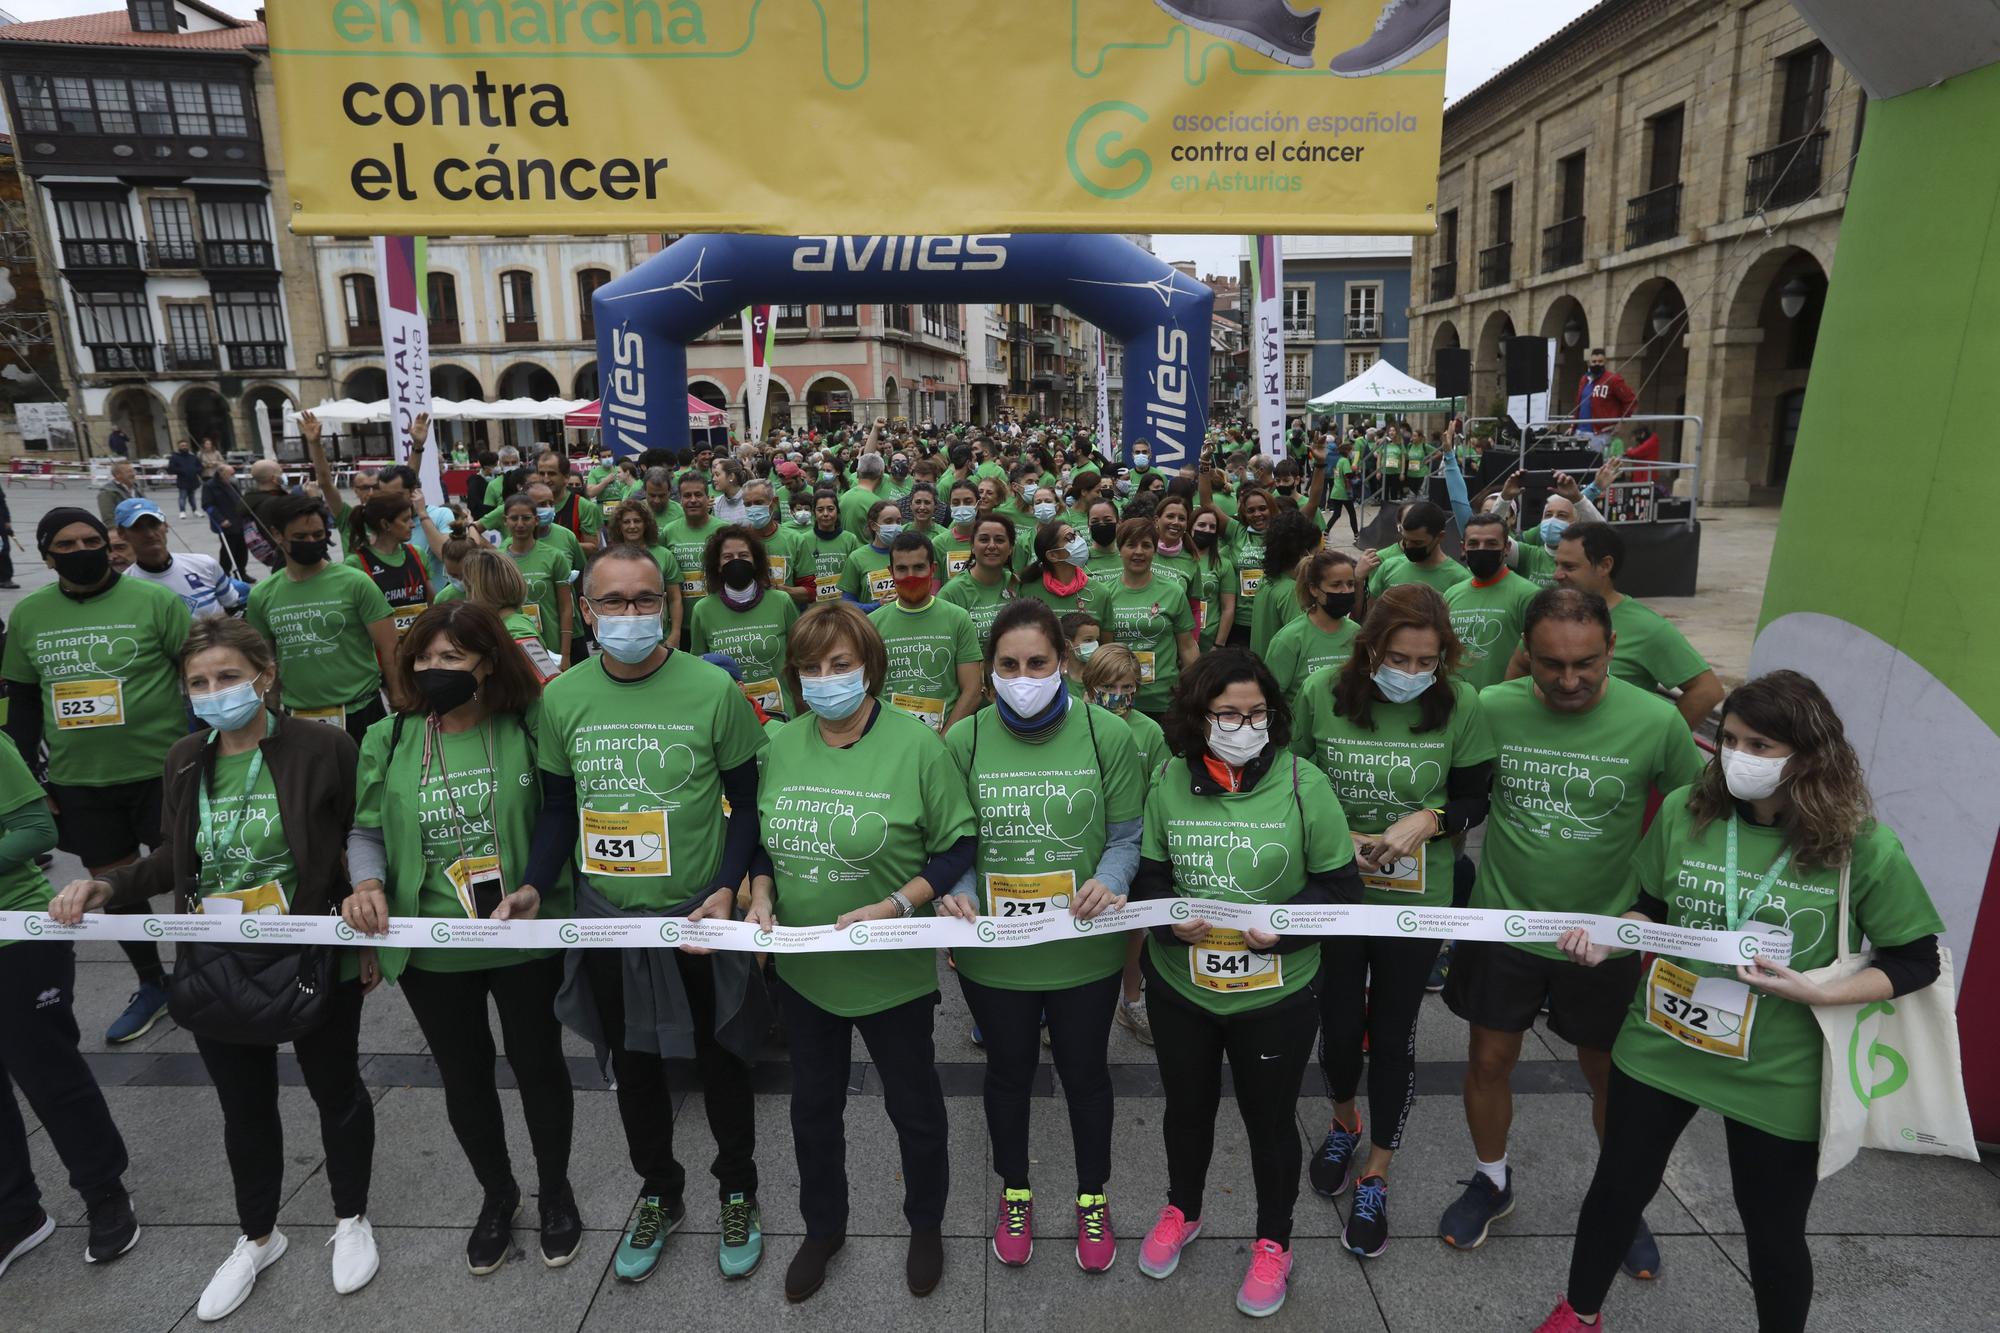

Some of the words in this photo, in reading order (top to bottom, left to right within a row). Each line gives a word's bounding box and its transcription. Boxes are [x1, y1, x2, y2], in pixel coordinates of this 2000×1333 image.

[332, 0, 422, 44] en
[444, 0, 706, 45] marcha
[343, 71, 568, 127] contra
[1173, 111, 1299, 132] asociación
[1307, 111, 1417, 137] española
[1171, 141, 1248, 162] contra
[1255, 141, 1275, 162] el
[1282, 141, 1364, 162] cáncer
[351, 143, 417, 200] el
[434, 144, 668, 200] cáncer
[1171, 174, 1199, 192] en
[1206, 171, 1302, 192] Asturias
[821, 585, 835, 594] 671
[877, 580, 895, 590] 472
[283, 608, 321, 621] marcha
[37, 639, 52, 651] En
[56, 633, 108, 648] marcha
[713, 638, 723, 646] En
[725, 632, 761, 643] marcha
[892, 642, 931, 654] marcha
[53, 662, 96, 676] cáncer
[891, 668, 923, 678] cáncer
[62, 700, 95, 715] 523
[667, 723, 694, 731] CÁNCER
[576, 737, 591, 753] En
[596, 734, 659, 750] marcha
[577, 755, 623, 772] contra
[1327, 747, 1343, 762] En
[1349, 752, 1410, 767] marcha
[1533, 748, 1561, 756] MARCHA
[1562, 752, 1590, 760] CONTRA
[1602, 755, 1629, 765] CÁNCER
[1328, 766, 1374, 783] contra
[1500, 754, 1518, 770] En
[1524, 762, 1589, 779] marcha
[590, 775, 645, 791] cáncer
[979, 784, 996, 799] En
[1003, 781, 1065, 797] marcha
[1341, 783, 1395, 800] cáncer
[1501, 775, 1550, 793] contra
[865, 791, 891, 799] CÁNCER
[1504, 791, 1513, 802] el
[1515, 793, 1572, 813] cáncer
[775, 796, 792, 810] En
[796, 799, 853, 816] marcha
[981, 801, 1030, 817] contra
[769, 817, 818, 833] contra
[981, 823, 992, 836] el
[996, 821, 1052, 836] cáncer
[768, 833, 779, 848] el
[783, 835, 835, 854] cáncer
[1168, 830, 1181, 846] En
[1187, 832, 1250, 848] marcha
[595, 839, 635, 857] 431
[1171, 851, 1213, 867] contra
[1185, 871, 1235, 888] cáncer
[1678, 870, 1697, 889] En
[1802, 883, 1835, 896] CÁNCER
[1004, 902, 1046, 917] 237
[1191, 903, 1222, 911] asociación
[1224, 907, 1252, 915] española
[1218, 911, 1238, 919] cáncer
[1643, 934, 1665, 943] contra
[1675, 938, 1701, 947] cáncer
[1644, 928, 1682, 938] asociación
[1684, 933, 1718, 943] española
[1653, 942, 1682, 951] Asturias
[1206, 954, 1249, 974] 541
[1663, 993, 1708, 1030] 372
